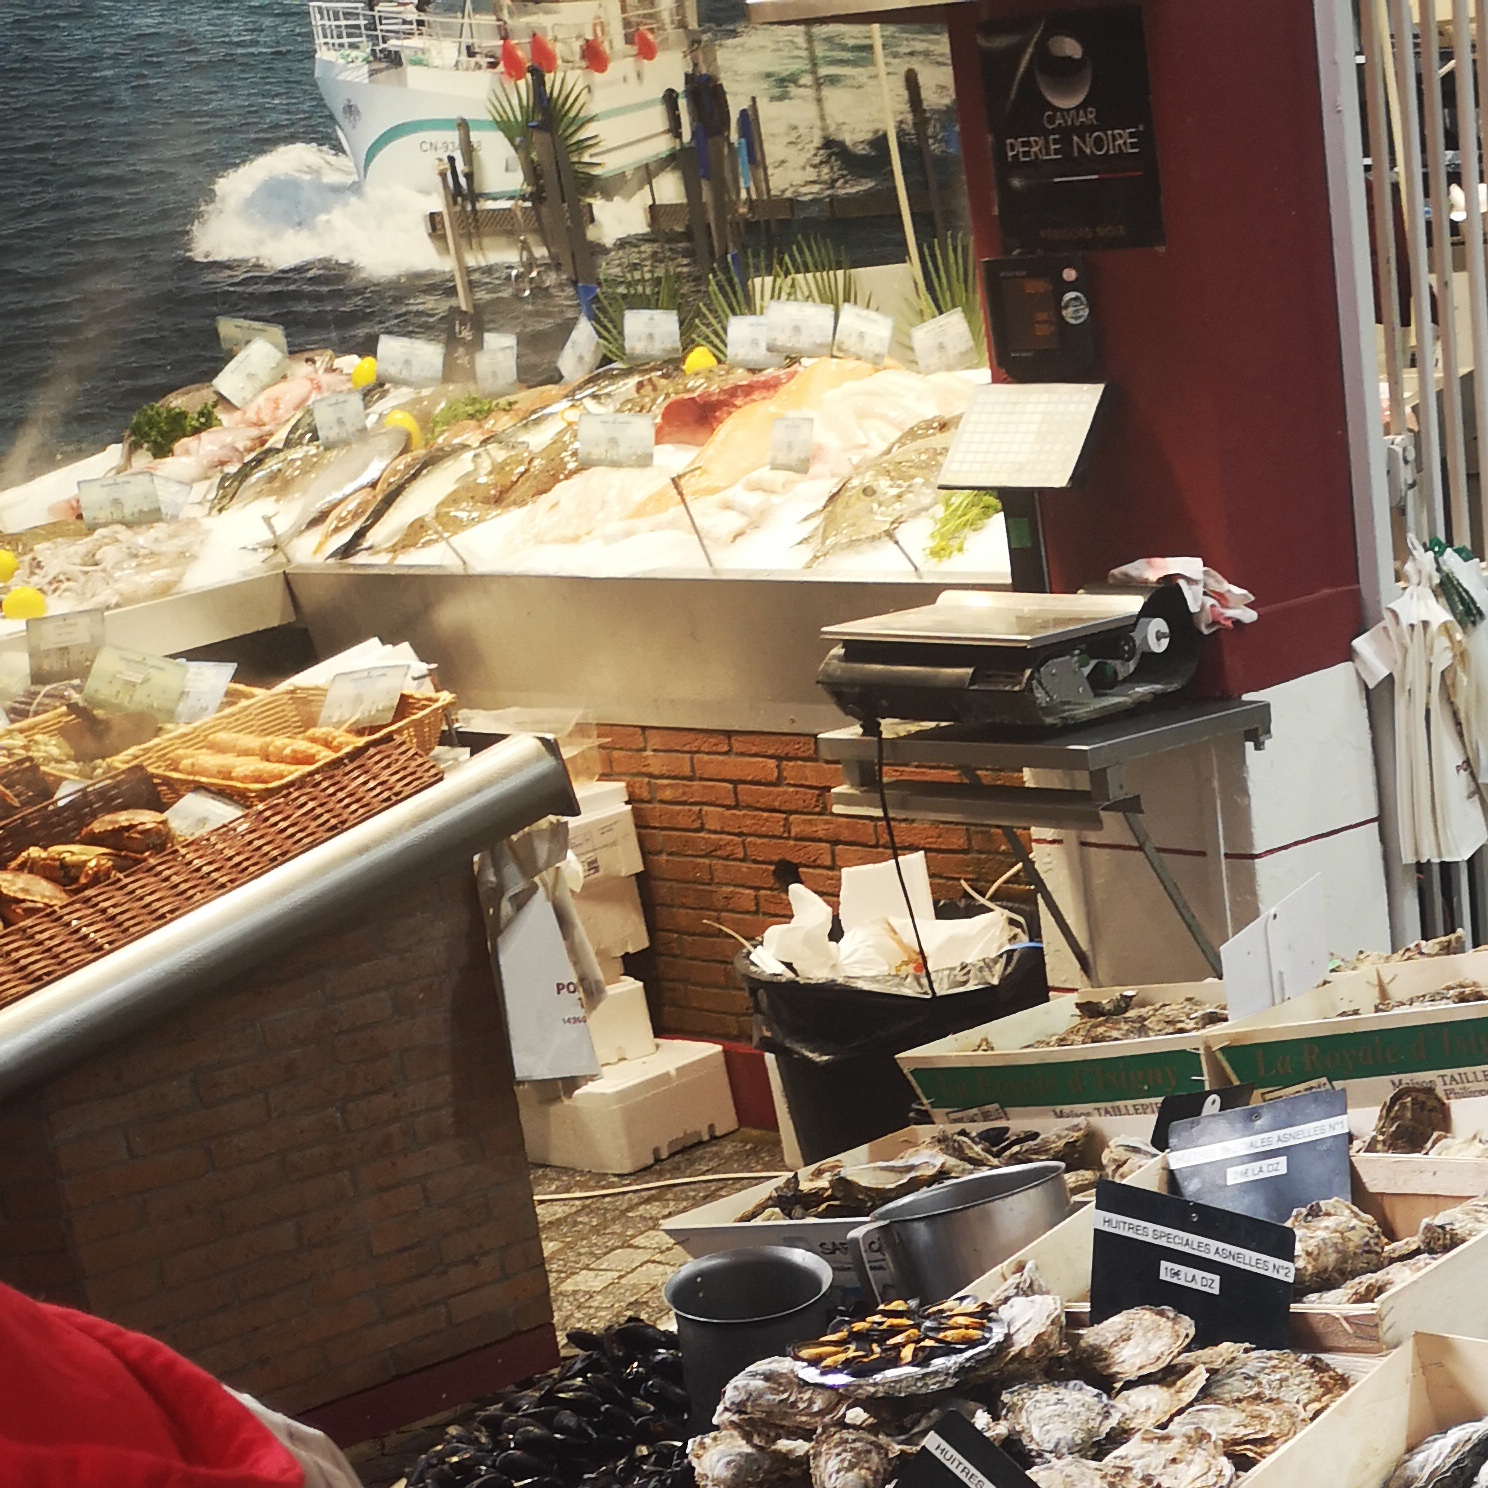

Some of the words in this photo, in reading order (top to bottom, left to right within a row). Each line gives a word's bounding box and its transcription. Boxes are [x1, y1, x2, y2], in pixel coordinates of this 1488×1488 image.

[1043, 107, 1098, 129] CAVIAR
[1006, 135, 1063, 162] PERLE
[1072, 128, 1141, 157] NOIRE
[1256, 1049, 1293, 1078] La
[1304, 1036, 1400, 1076] Royale
[1276, 1126, 1326, 1144] ASNELLES
[1251, 1165, 1265, 1176] LA
[1266, 1162, 1280, 1173] DZ
[1103, 1217, 1149, 1237] HUITRES
[1152, 1229, 1211, 1255] SPECIALES
[1213, 1246, 1269, 1272] ASNELLES
[1272, 1263, 1291, 1279] N°2
[1184, 1272, 1198, 1286] LA
[1201, 1276, 1216, 1290] DZ
